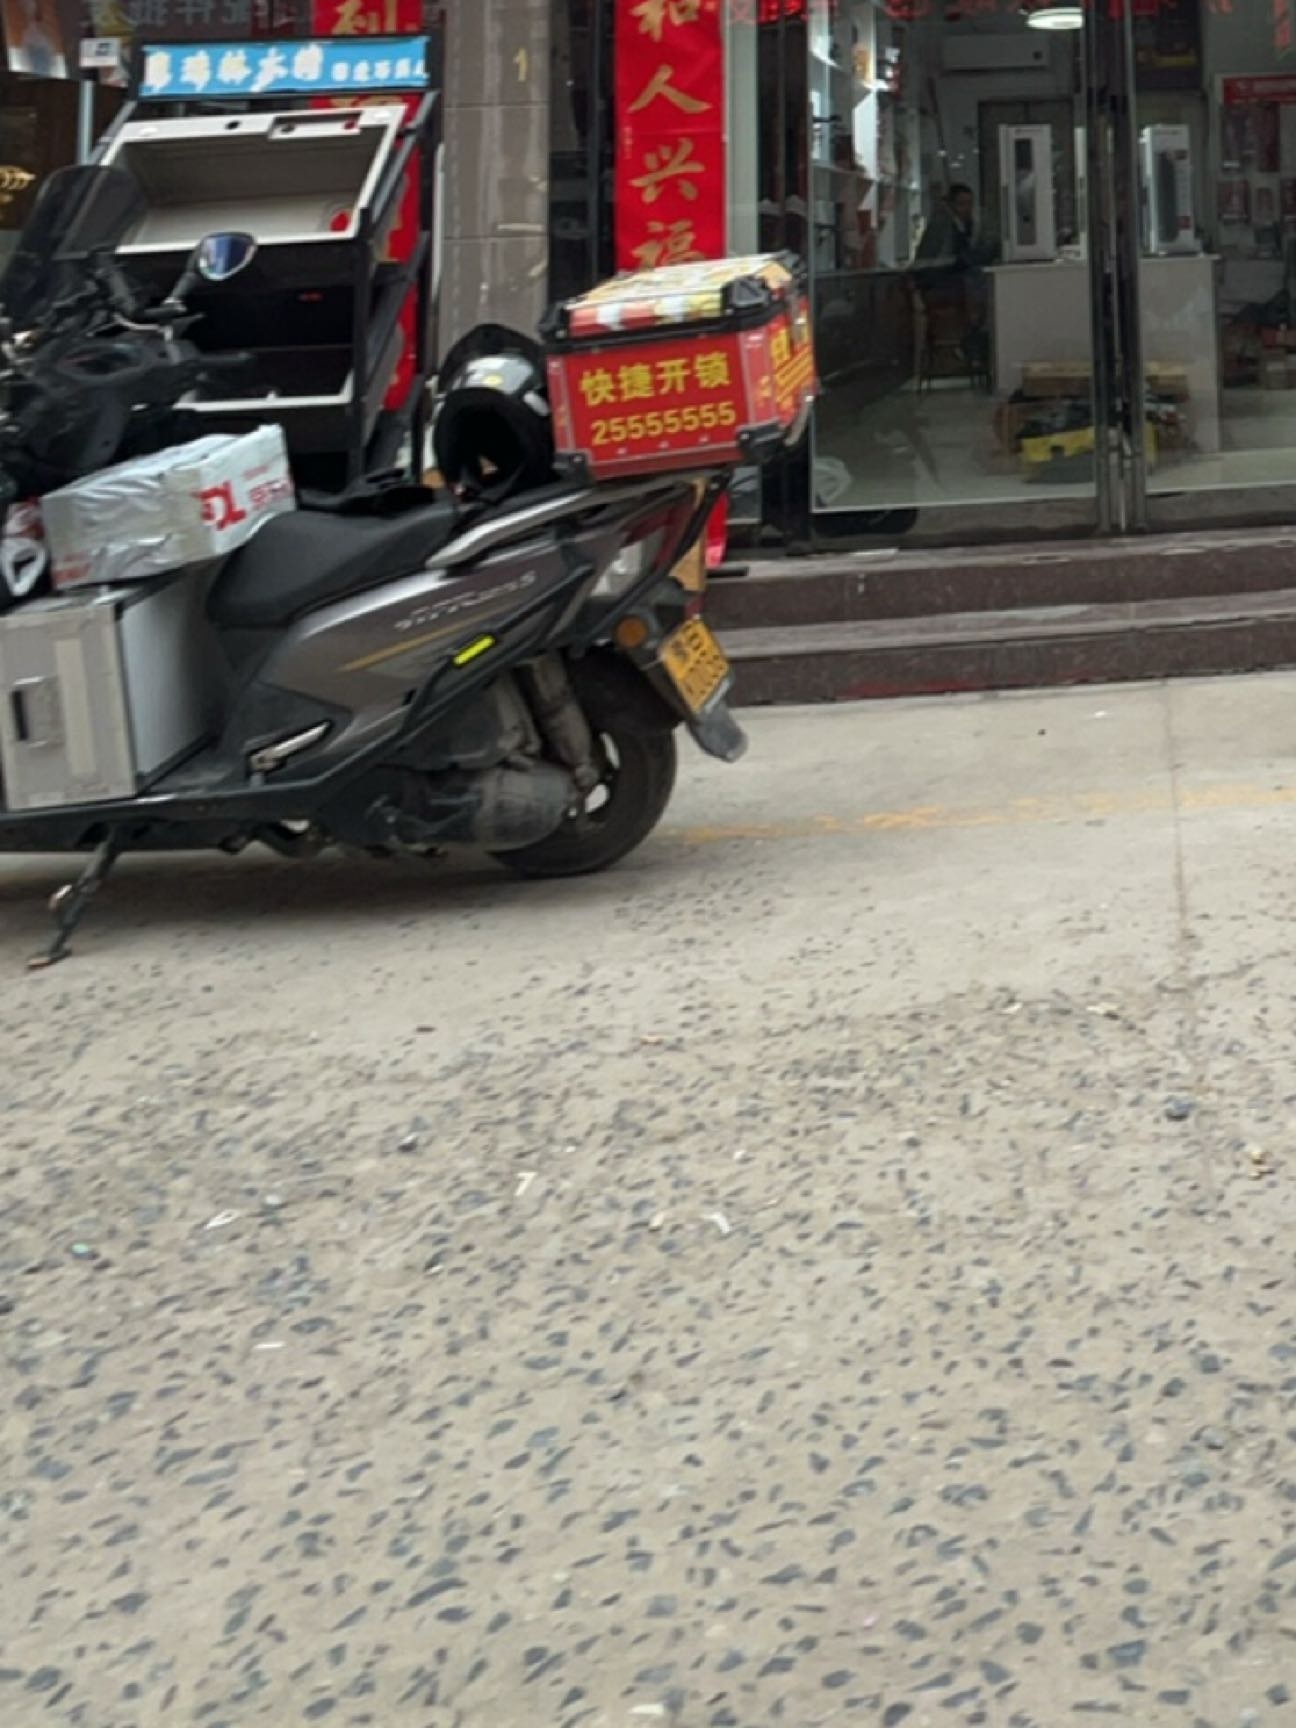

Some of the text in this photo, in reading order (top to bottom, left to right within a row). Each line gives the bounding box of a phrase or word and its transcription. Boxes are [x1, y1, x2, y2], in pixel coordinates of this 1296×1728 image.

[580, 351, 731, 408] 快捷开锁
[590, 400, 737, 447] 25555555
